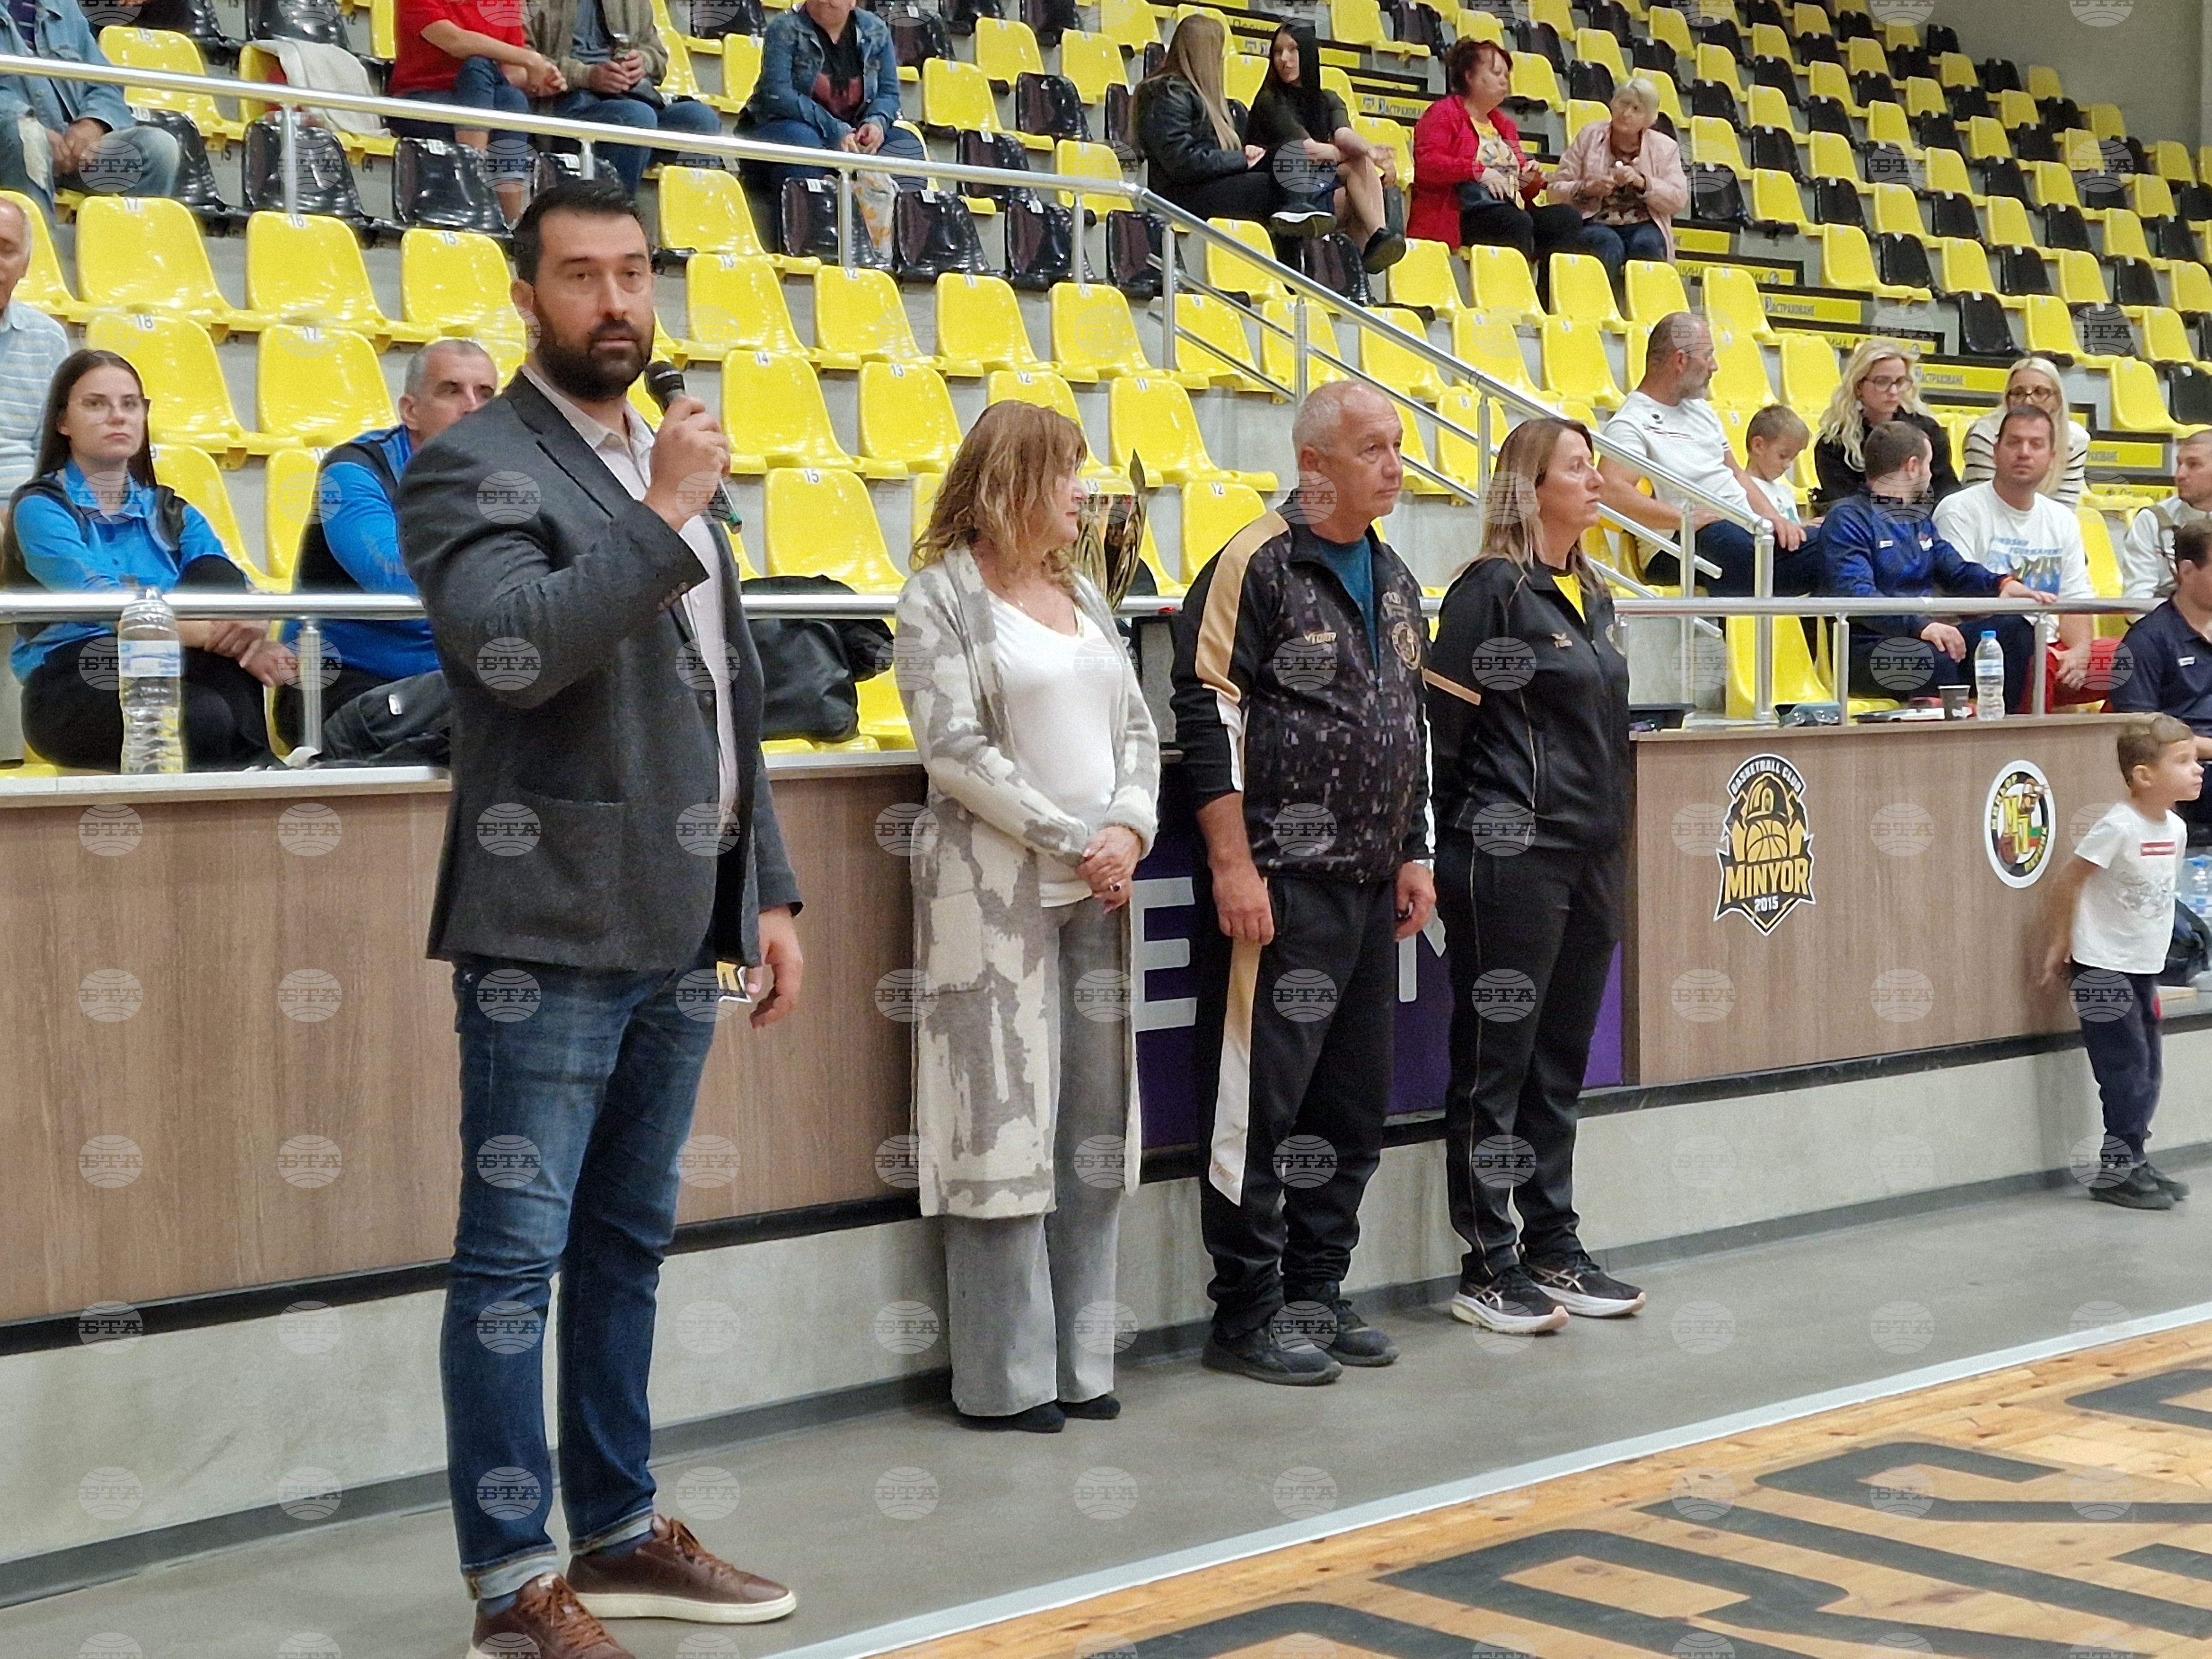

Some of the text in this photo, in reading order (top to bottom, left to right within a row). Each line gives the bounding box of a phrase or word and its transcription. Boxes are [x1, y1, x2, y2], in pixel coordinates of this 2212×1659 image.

[222, 144, 234, 161] 15
[289, 214, 304, 227] 16
[441, 232, 457, 245] 15
[720, 255, 734, 268] 13
[844, 267, 858, 279] 12
[137, 314, 153, 328] 18
[755, 352, 769, 364] 14
[890, 364, 905, 377] 13
[1018, 371, 1031, 384] 12
[1136, 378, 1147, 390] 11
[1731, 412, 1738, 424] 5
[804, 469, 820, 483] 15
[1086, 479, 1099, 492] 13
[1211, 482, 1224, 495] 12
[1730, 759, 1802, 795] BASKETBALL CLUB
[1724, 857, 1809, 905] MINYOR
[1754, 895, 1780, 913] 2015
